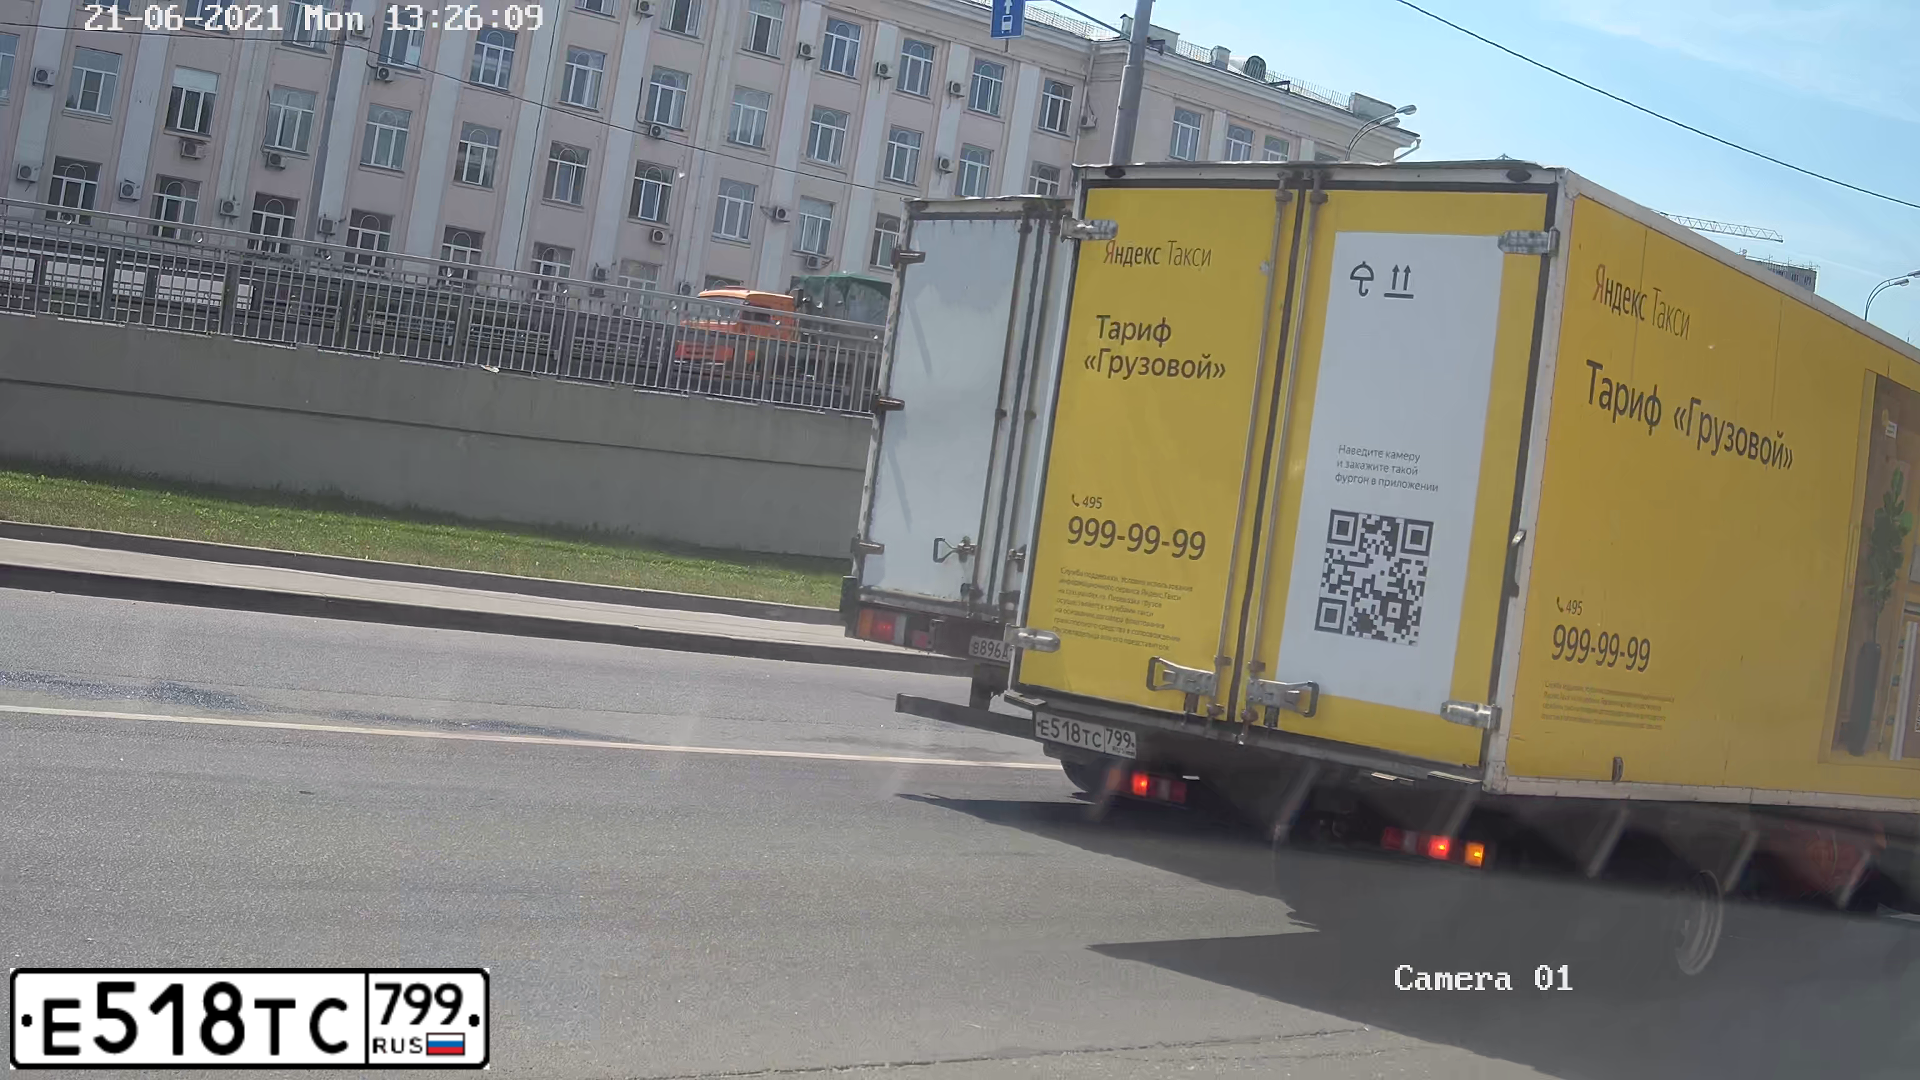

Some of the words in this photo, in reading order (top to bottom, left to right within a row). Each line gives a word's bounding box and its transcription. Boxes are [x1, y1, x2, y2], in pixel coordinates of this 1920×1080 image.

[1103, 240, 1162, 267] Яндекс
[1167, 240, 1212, 267] Такси
[1592, 263, 1648, 321] Яндекс
[1652, 287, 1690, 340] Такси
[1096, 315, 1172, 348] Тариф
[1084, 348, 1226, 380] «Грузовой»
[1586, 359, 1662, 436] Тариф
[1673, 397, 1793, 470] «Грузовой»
[1338, 444, 1384, 458] Наведите
[1385, 450, 1421, 463] камеру
[1344, 460, 1389, 473] закажите
[1391, 465, 1418, 476] такой
[1335, 473, 1370, 486] фургон
[1378, 477, 1439, 493] приложении
[1082, 496, 1103, 510] 495
[1067, 516, 1206, 560] 999-99-99
[1566, 600, 1583, 616] 495
[1551, 624, 1650, 673] 999-99-99
[1105, 728, 1132, 748] 799
